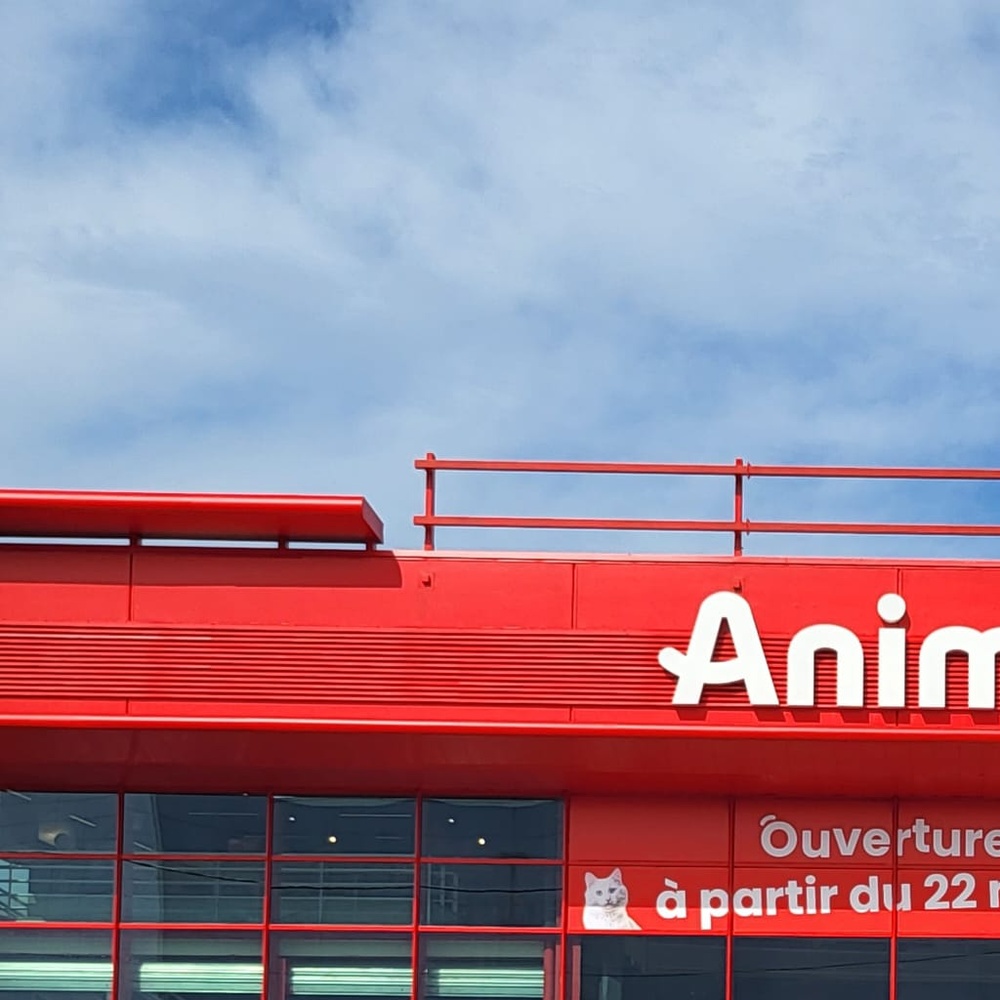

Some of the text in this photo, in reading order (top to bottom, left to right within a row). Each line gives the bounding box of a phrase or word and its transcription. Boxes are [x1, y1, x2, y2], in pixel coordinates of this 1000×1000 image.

[656, 878, 687, 919] à
[699, 875, 838, 930] partir
[849, 875, 912, 914] du
[924, 873, 977, 910] 22
